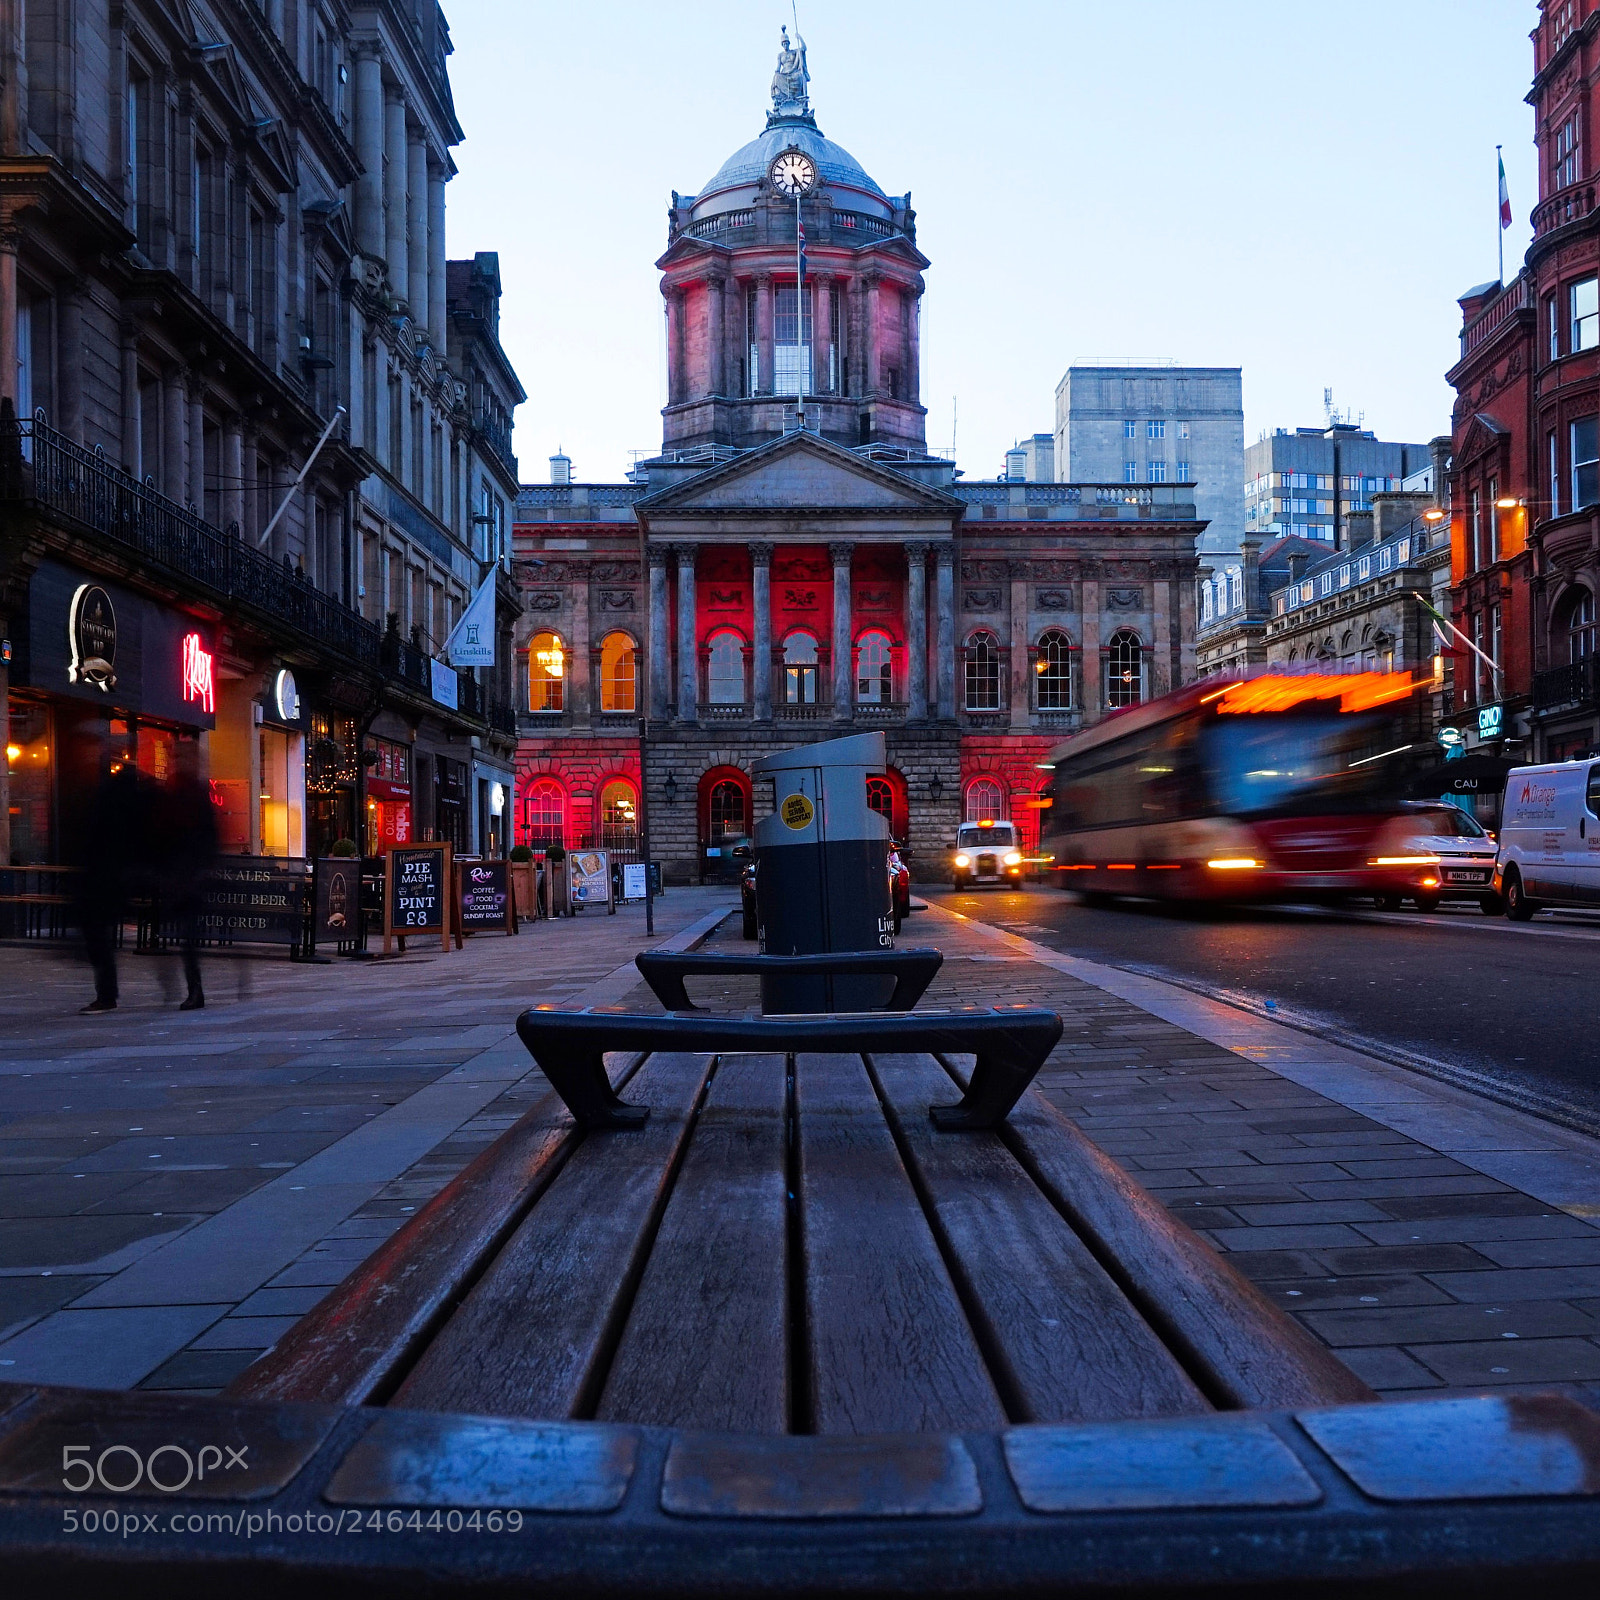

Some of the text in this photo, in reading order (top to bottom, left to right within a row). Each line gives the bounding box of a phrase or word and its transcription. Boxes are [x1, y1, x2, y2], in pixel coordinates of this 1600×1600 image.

[454, 647, 492, 655] Linskills
[1478, 706, 1499, 730] GINO
[1454, 778, 1478, 788] CAU
[404, 862, 430, 874] PIE
[235, 870, 271, 882] ALES
[401, 873, 433, 884] MASH
[470, 867, 494, 884] Rox
[472, 886, 496, 894] COFFEE
[250, 894, 287, 906] BEER
[399, 896, 436, 909] PINT
[197, 914, 267, 929] PUB GRUB
[406, 911, 427, 926] £8
